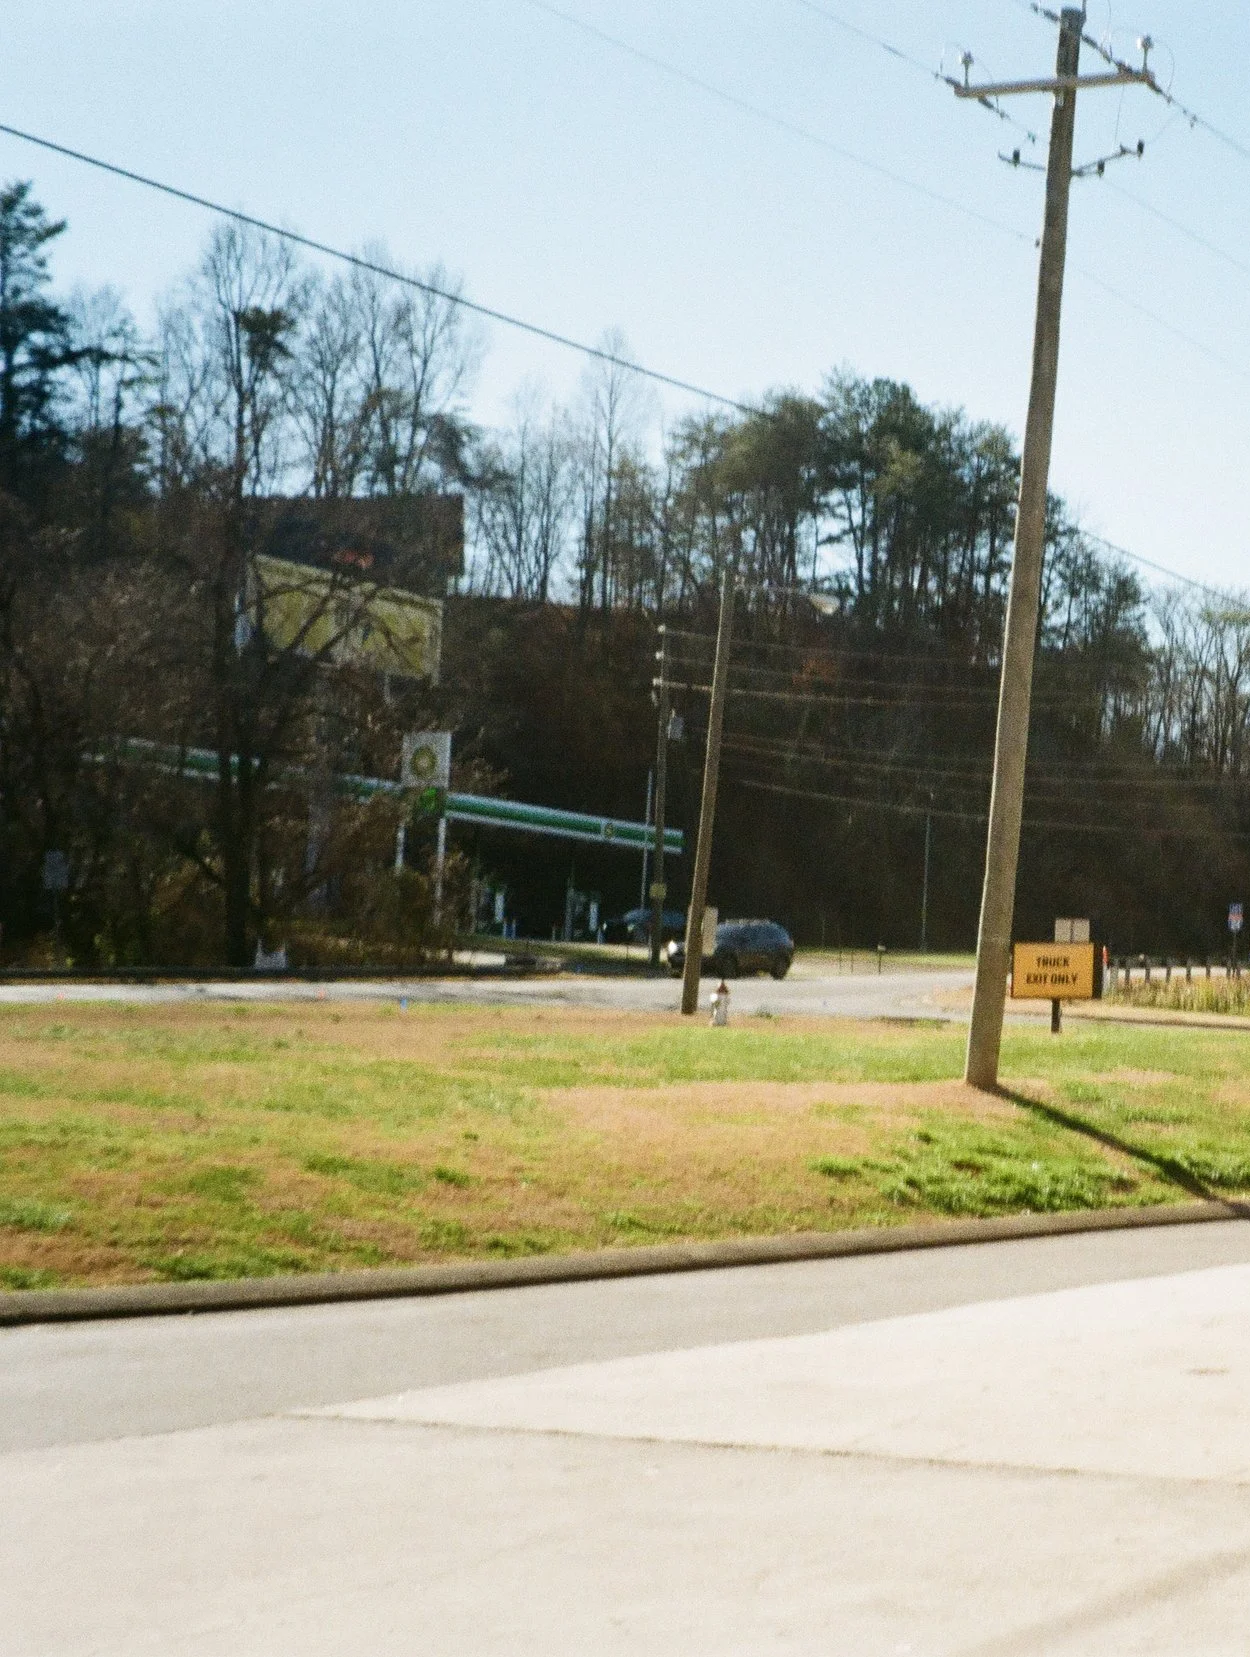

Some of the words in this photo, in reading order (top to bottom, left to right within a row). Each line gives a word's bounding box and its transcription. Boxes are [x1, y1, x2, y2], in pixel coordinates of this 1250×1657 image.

[1036, 955, 1070, 968] TRUCK
[1026, 973, 1048, 985] EXIT
[1050, 972, 1078, 985] ONLY
